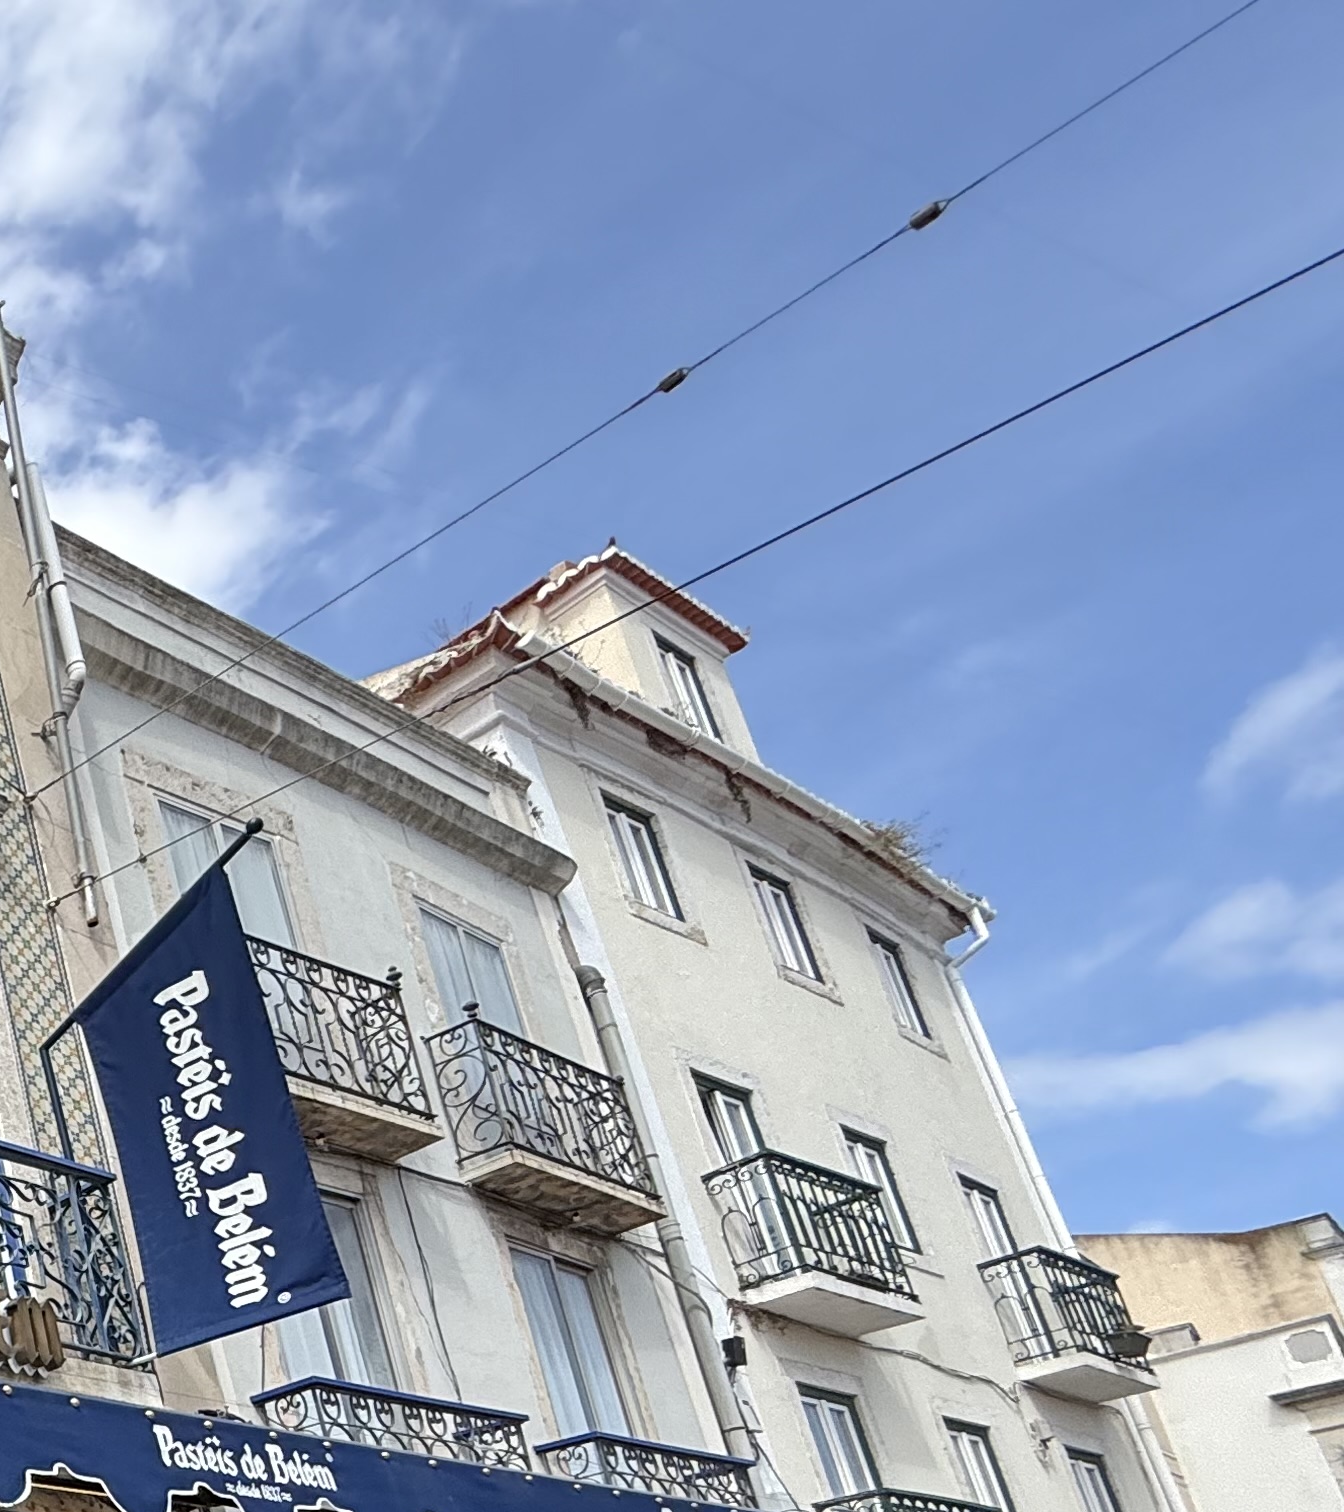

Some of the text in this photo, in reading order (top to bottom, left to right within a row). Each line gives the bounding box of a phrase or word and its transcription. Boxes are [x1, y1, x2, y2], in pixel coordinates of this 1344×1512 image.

[153, 969, 277, 1308] Pastéis de Belém
[160, 1113, 202, 1203] desde 1837
[152, 1423, 338, 1492] Pastéis de Belém
